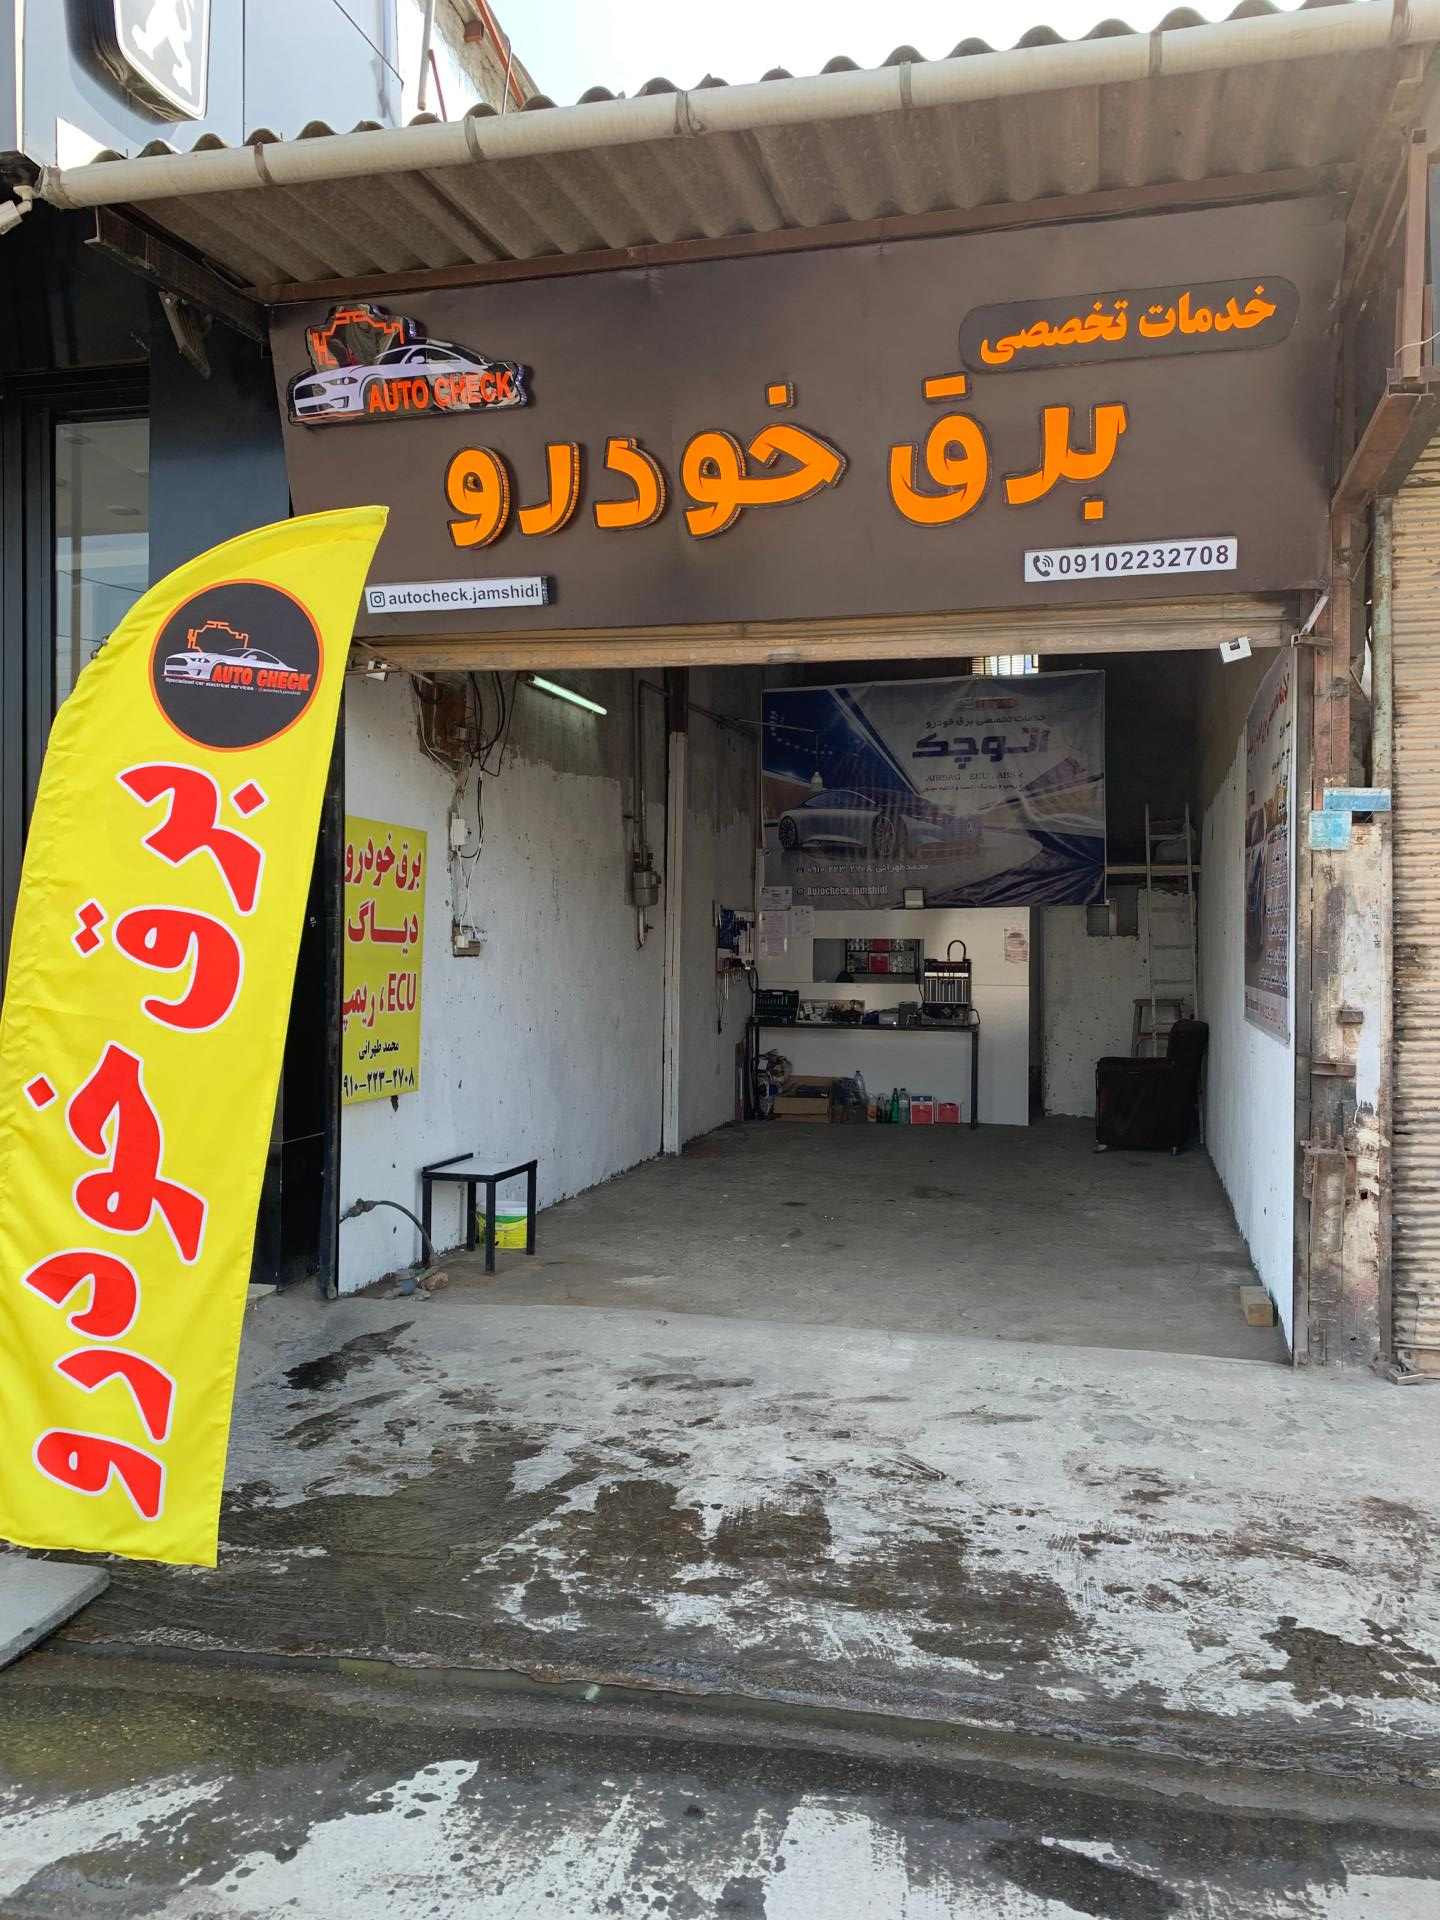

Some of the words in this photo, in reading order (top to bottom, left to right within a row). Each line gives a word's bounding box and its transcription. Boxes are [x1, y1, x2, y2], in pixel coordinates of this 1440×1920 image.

[980, 300, 1128, 364] تخصصی
[1139, 285, 1276, 337] خدمات
[368, 379, 428, 414] AUTO
[433, 370, 515, 411] CHECK
[446, 382, 846, 550] خودرو
[889, 372, 1128, 525] برق
[1058, 545, 1230, 575] 09102232708
[388, 583, 540, 607] autocheck.jamshidi
[212, 664, 253, 686] AUTO
[257, 669, 312, 691] CHECK
[926, 718, 953, 729] خودرو
[344, 832, 395, 886] خودرو
[395, 842, 422, 891] برق
[348, 900, 419, 955] دیاگ
[358, 1038, 382, 1060] طهرانی
[383, 1040, 399, 1053] محمد
